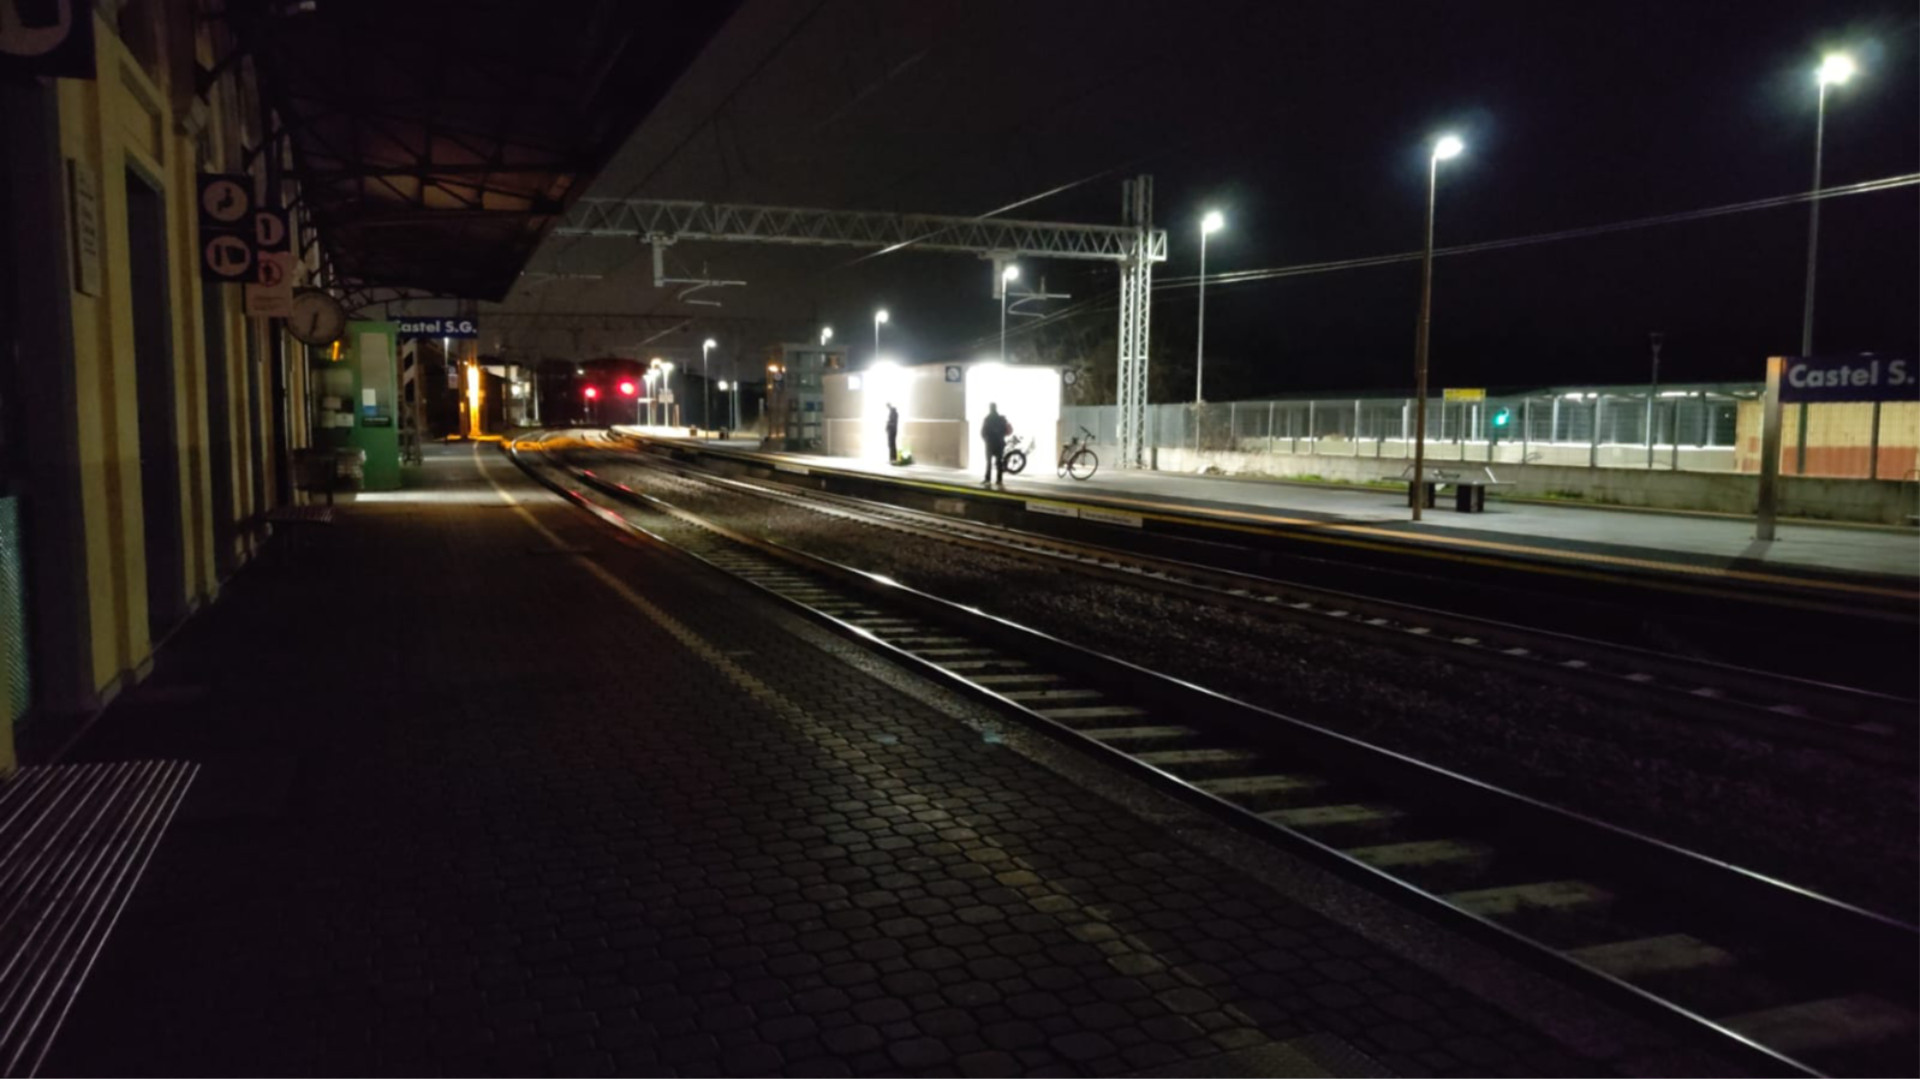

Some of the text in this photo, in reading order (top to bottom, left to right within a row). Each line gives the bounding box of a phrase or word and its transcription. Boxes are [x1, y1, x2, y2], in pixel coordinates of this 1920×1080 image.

[397, 320, 477, 334] astel S.G.
[1788, 359, 1916, 388] Castel S.
